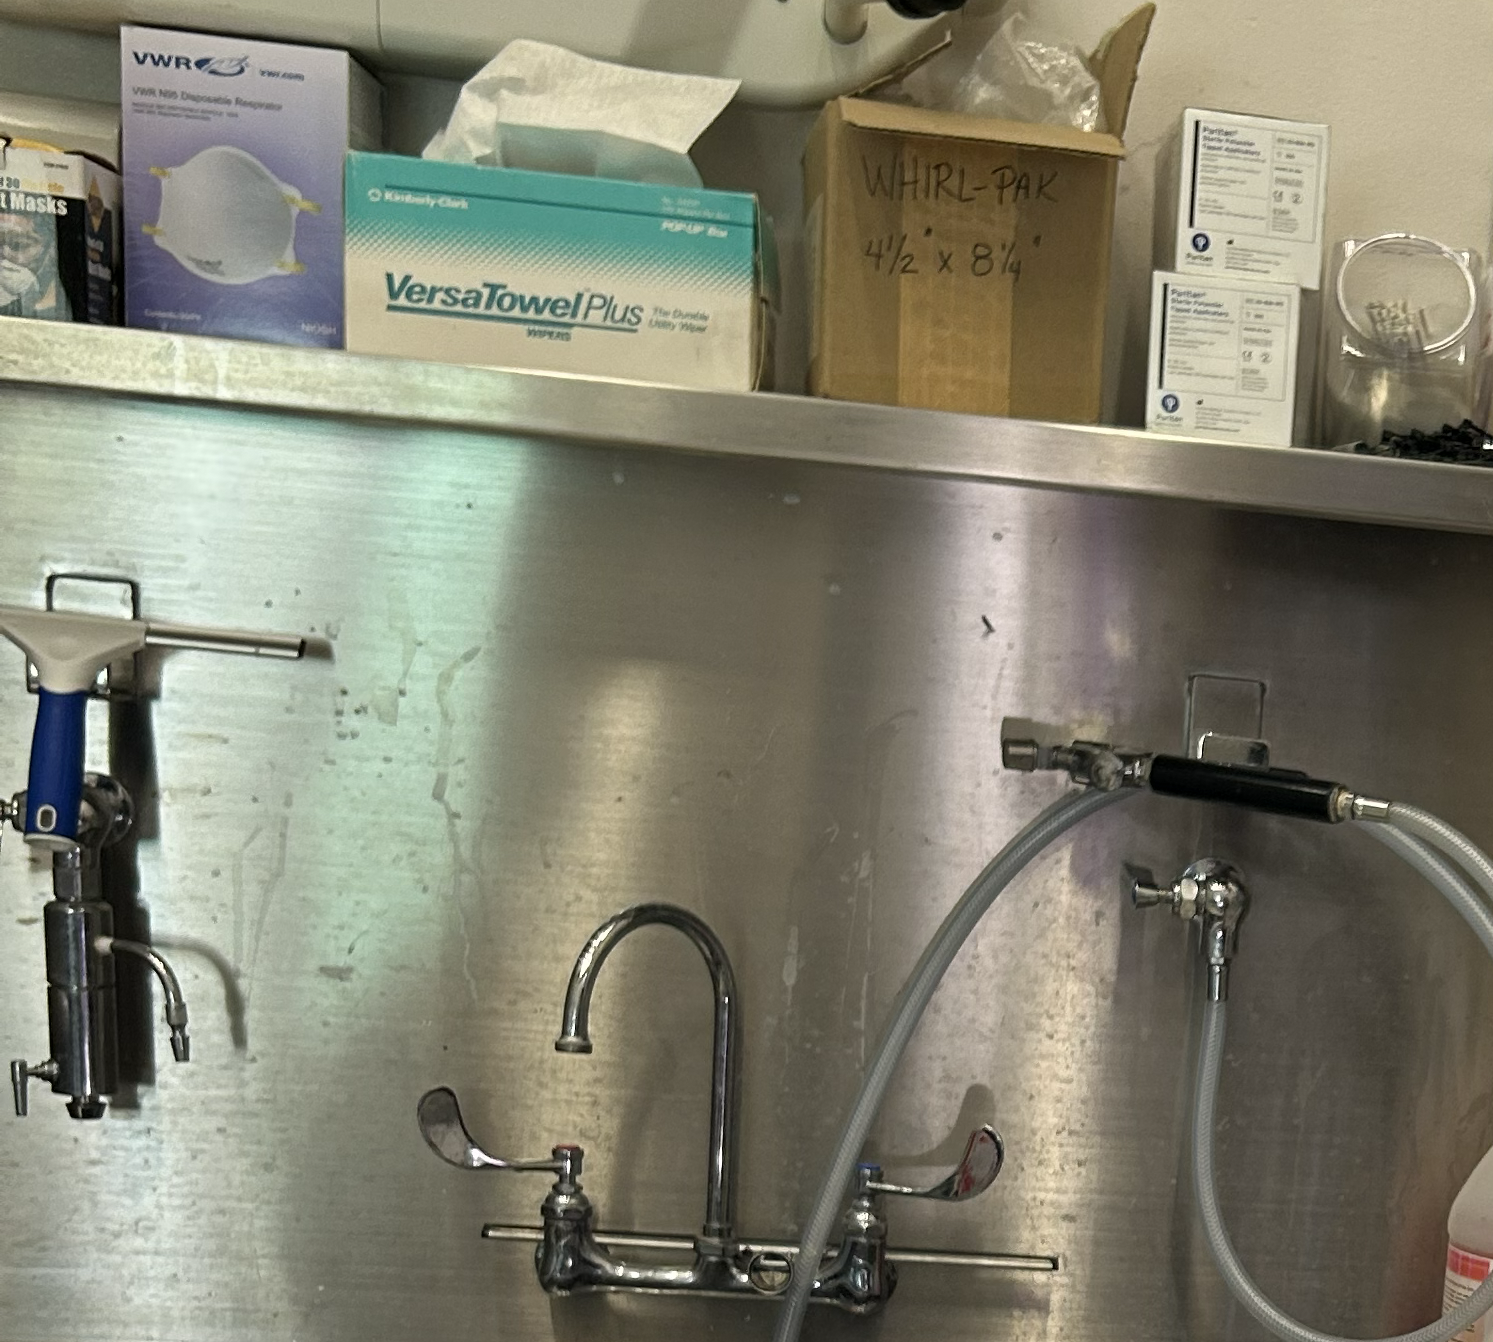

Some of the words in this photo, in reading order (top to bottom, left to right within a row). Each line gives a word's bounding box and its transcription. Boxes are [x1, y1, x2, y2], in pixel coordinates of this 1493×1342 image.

[132, 50, 193, 70] VWR
[862, 154, 1059, 205] WHIRL-PAK
[10, 192, 68, 216] Masks
[385, 272, 583, 320] VersaTowel
[582, 293, 644, 327] Plus
